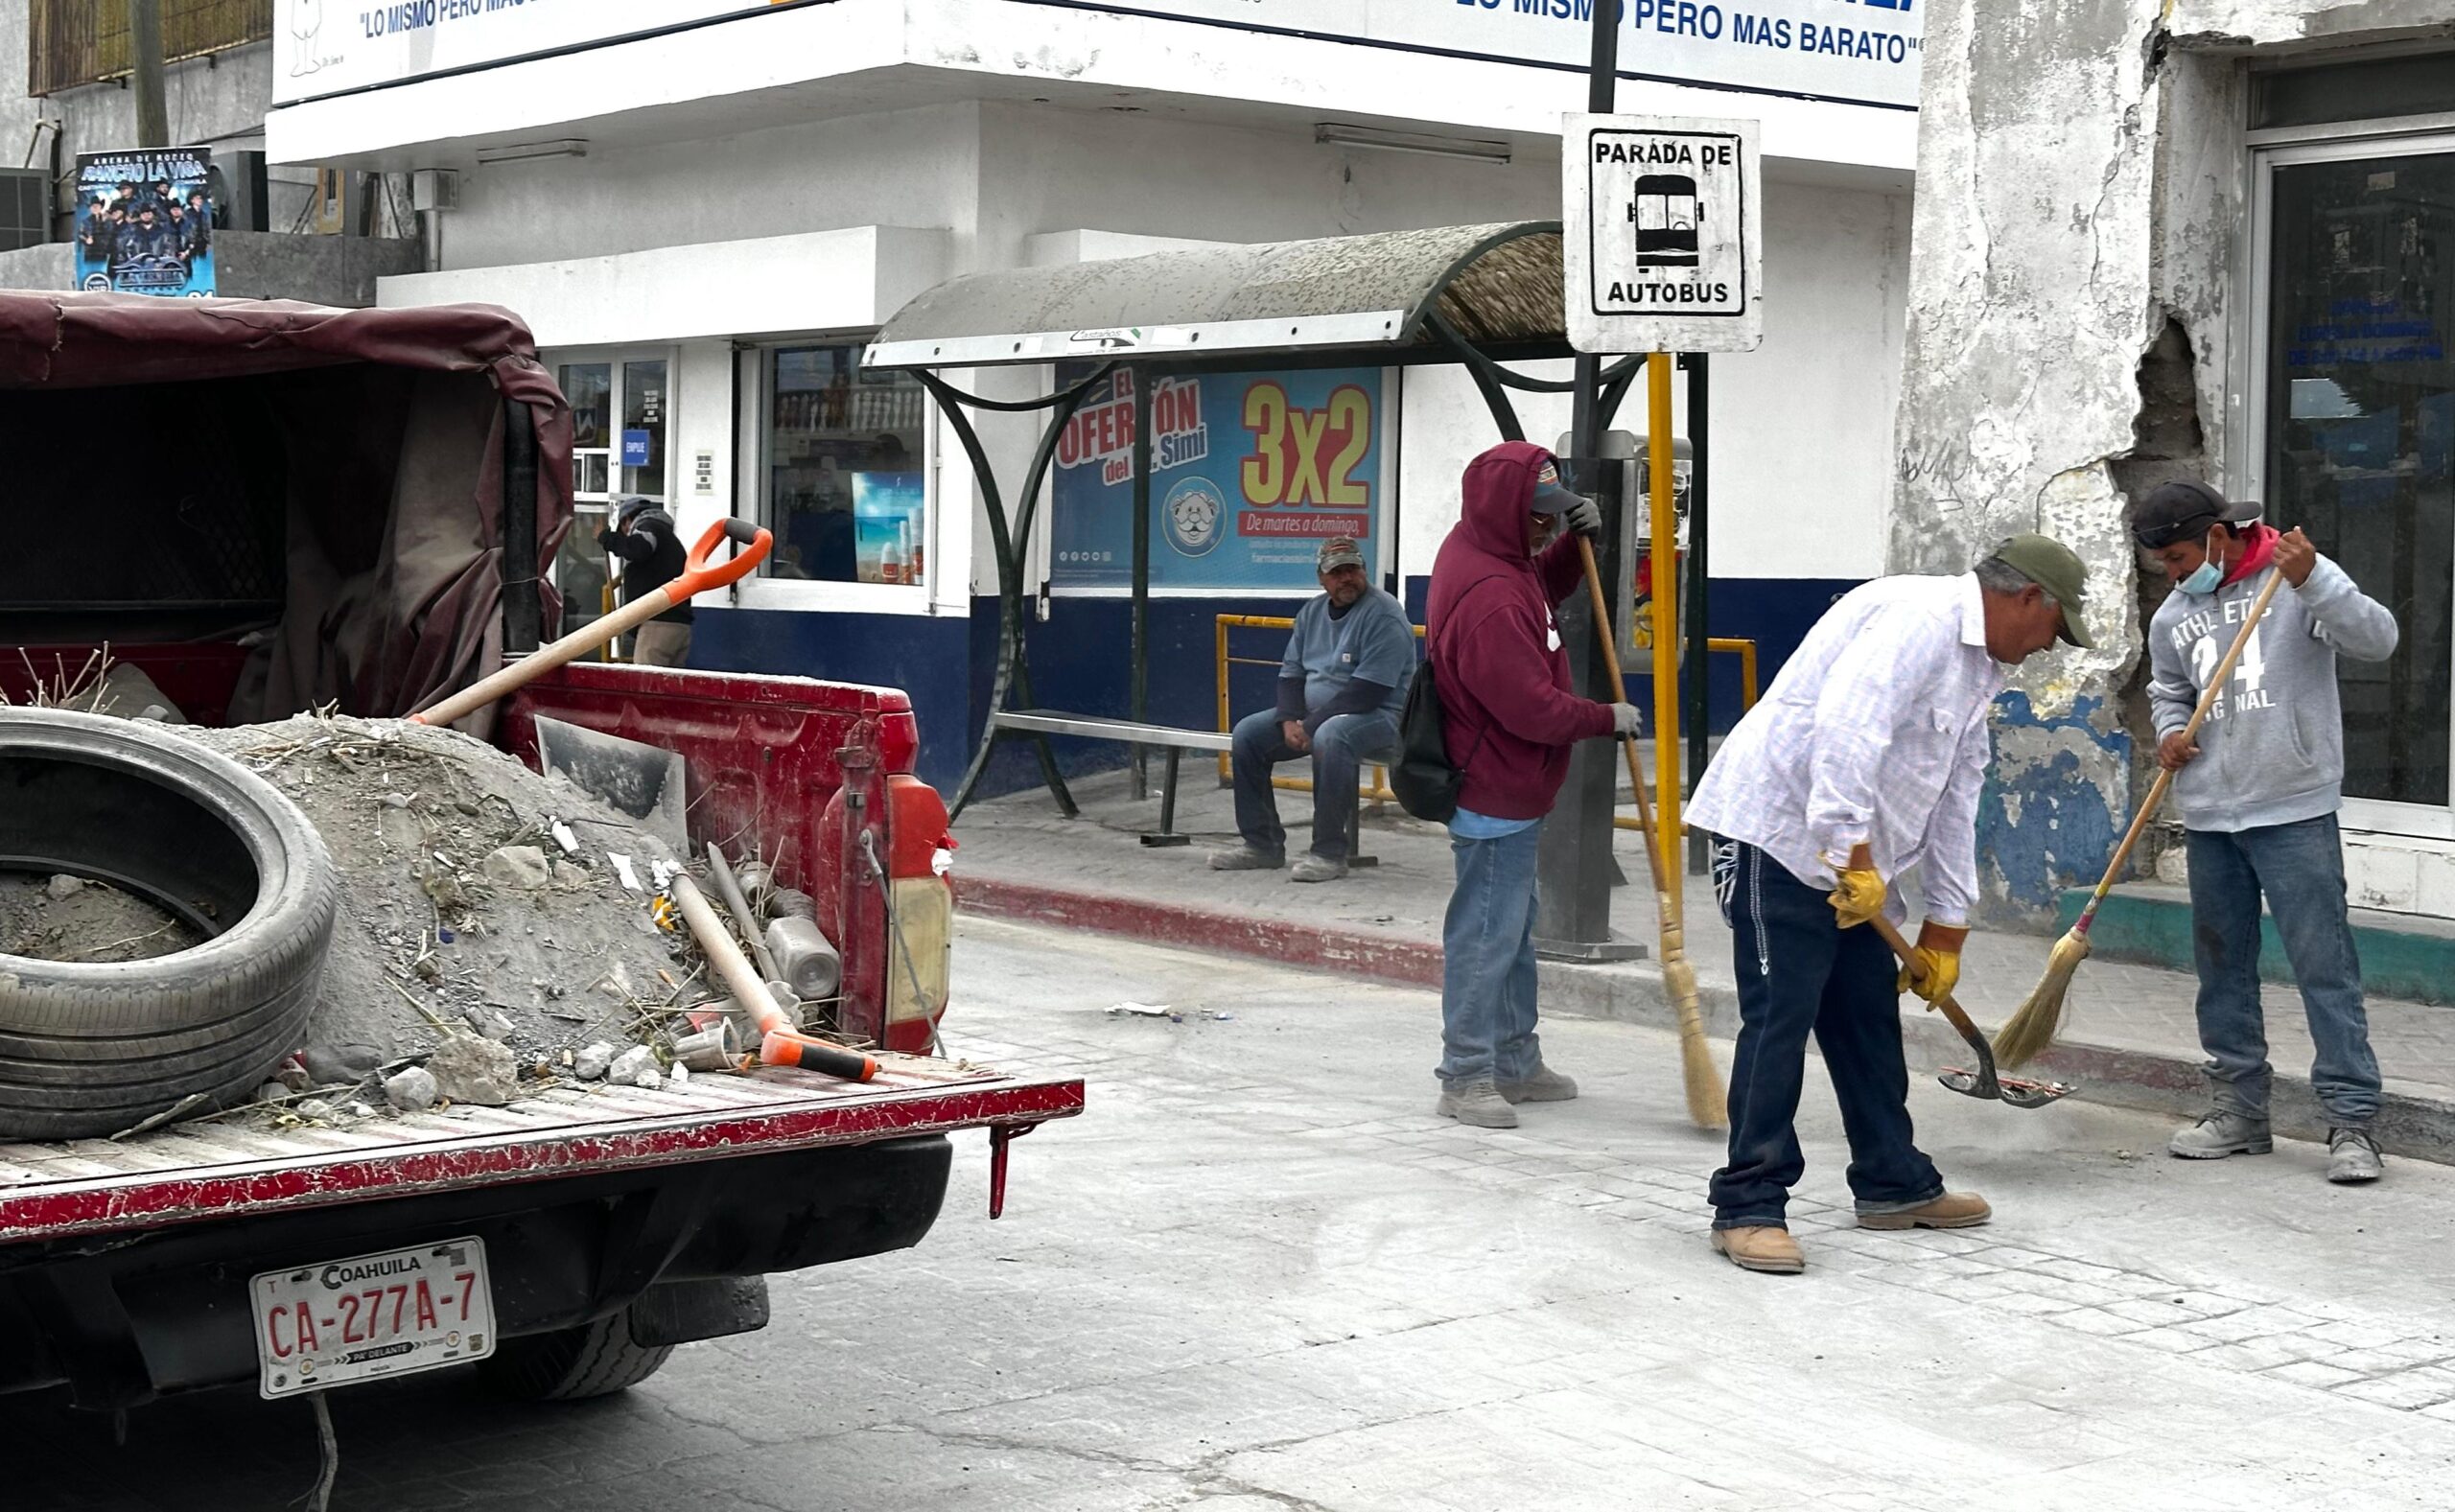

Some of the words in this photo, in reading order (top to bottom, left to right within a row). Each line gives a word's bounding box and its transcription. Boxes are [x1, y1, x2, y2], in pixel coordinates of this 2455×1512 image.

[387, 0, 435, 34] MISMO
[1635, 0, 1722, 39] PERO
[1733, 13, 1793, 50] MAS
[94, 156, 130, 165] ARENA
[1596, 142, 1694, 164] PARADA
[1701, 145, 1731, 165] DE
[81, 163, 145, 183] RANCHO
[148, 162, 169, 182] LA
[1607, 282, 1728, 303] AUTOBUS
[1115, 371, 1134, 399] EL
[1059, 381, 1199, 465] OFERÓN
[1105, 455, 1130, 482] del
[1159, 426, 1205, 466] Simi
[1247, 514, 1261, 531] De
[1263, 517, 1300, 532] martes
[1302, 520, 1311, 532] a
[319, 1256, 422, 1290] COAHUILA
[267, 1280, 277, 1294] T
[268, 1271, 477, 1359] CA-277A-7
[366, 1342, 410, 1359] DELANTE
